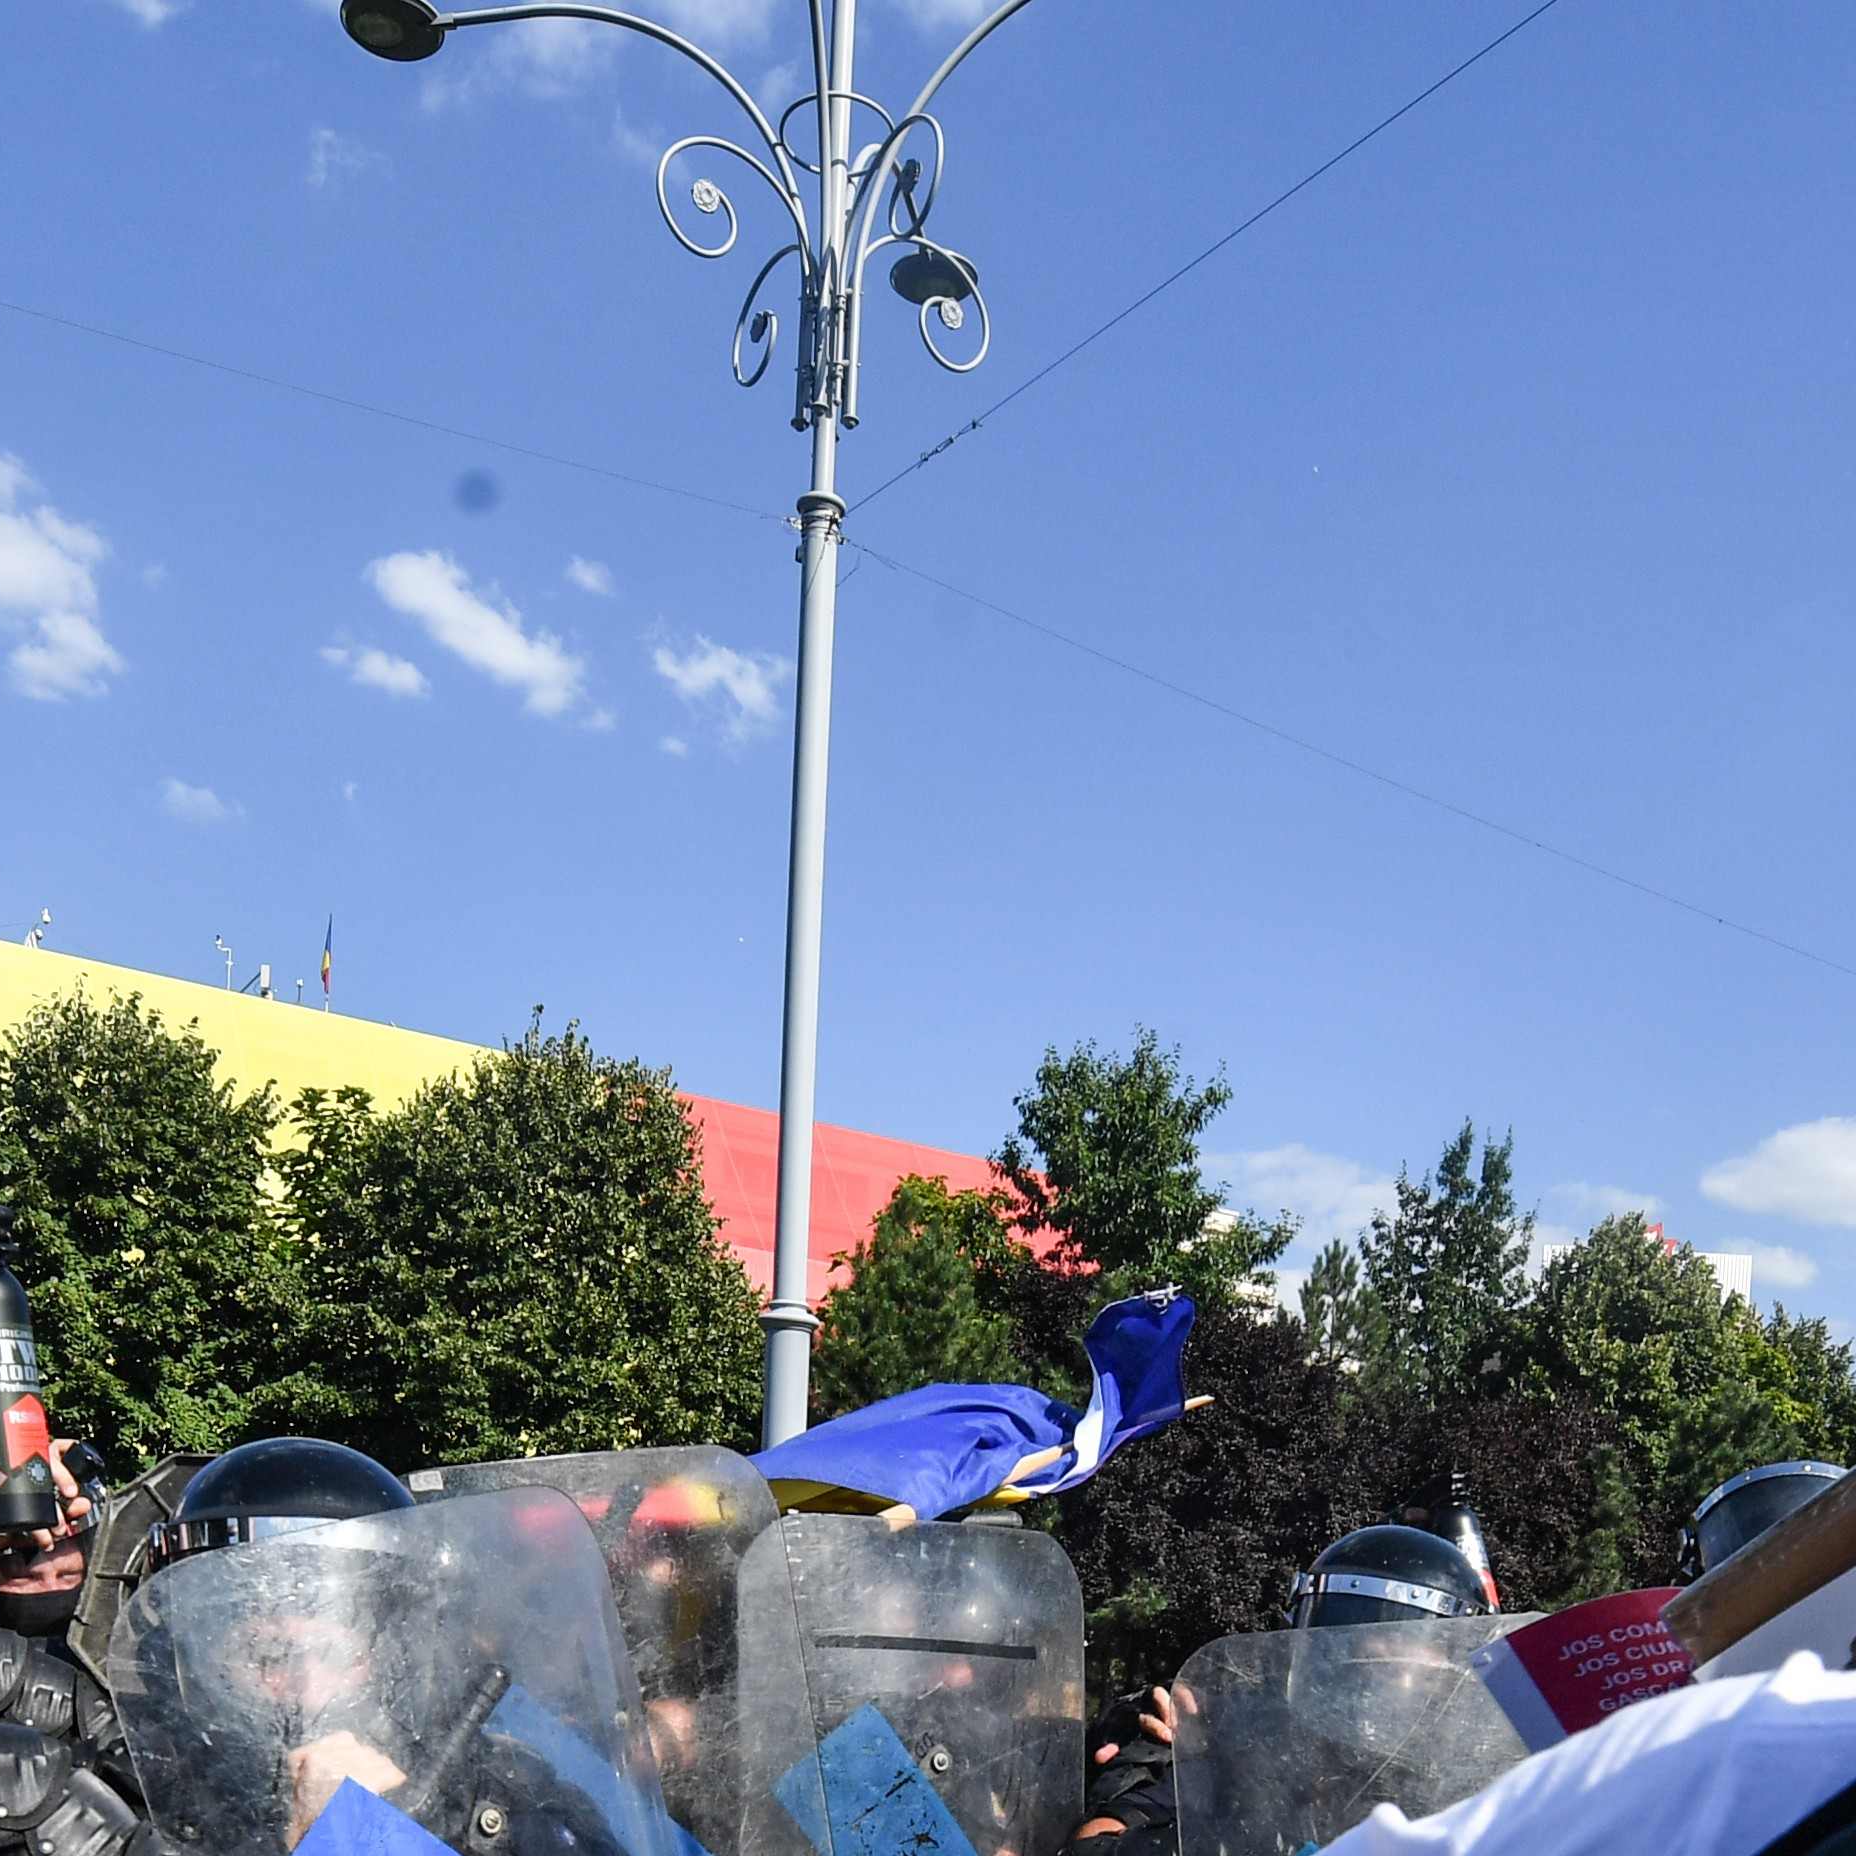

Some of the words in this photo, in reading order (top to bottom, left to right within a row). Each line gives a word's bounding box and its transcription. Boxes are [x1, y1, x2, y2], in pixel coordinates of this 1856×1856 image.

[1558, 1634, 1605, 1660] JOS
[1573, 1651, 1620, 1678] JOS
[1600, 1666, 1648, 1690] JOS
